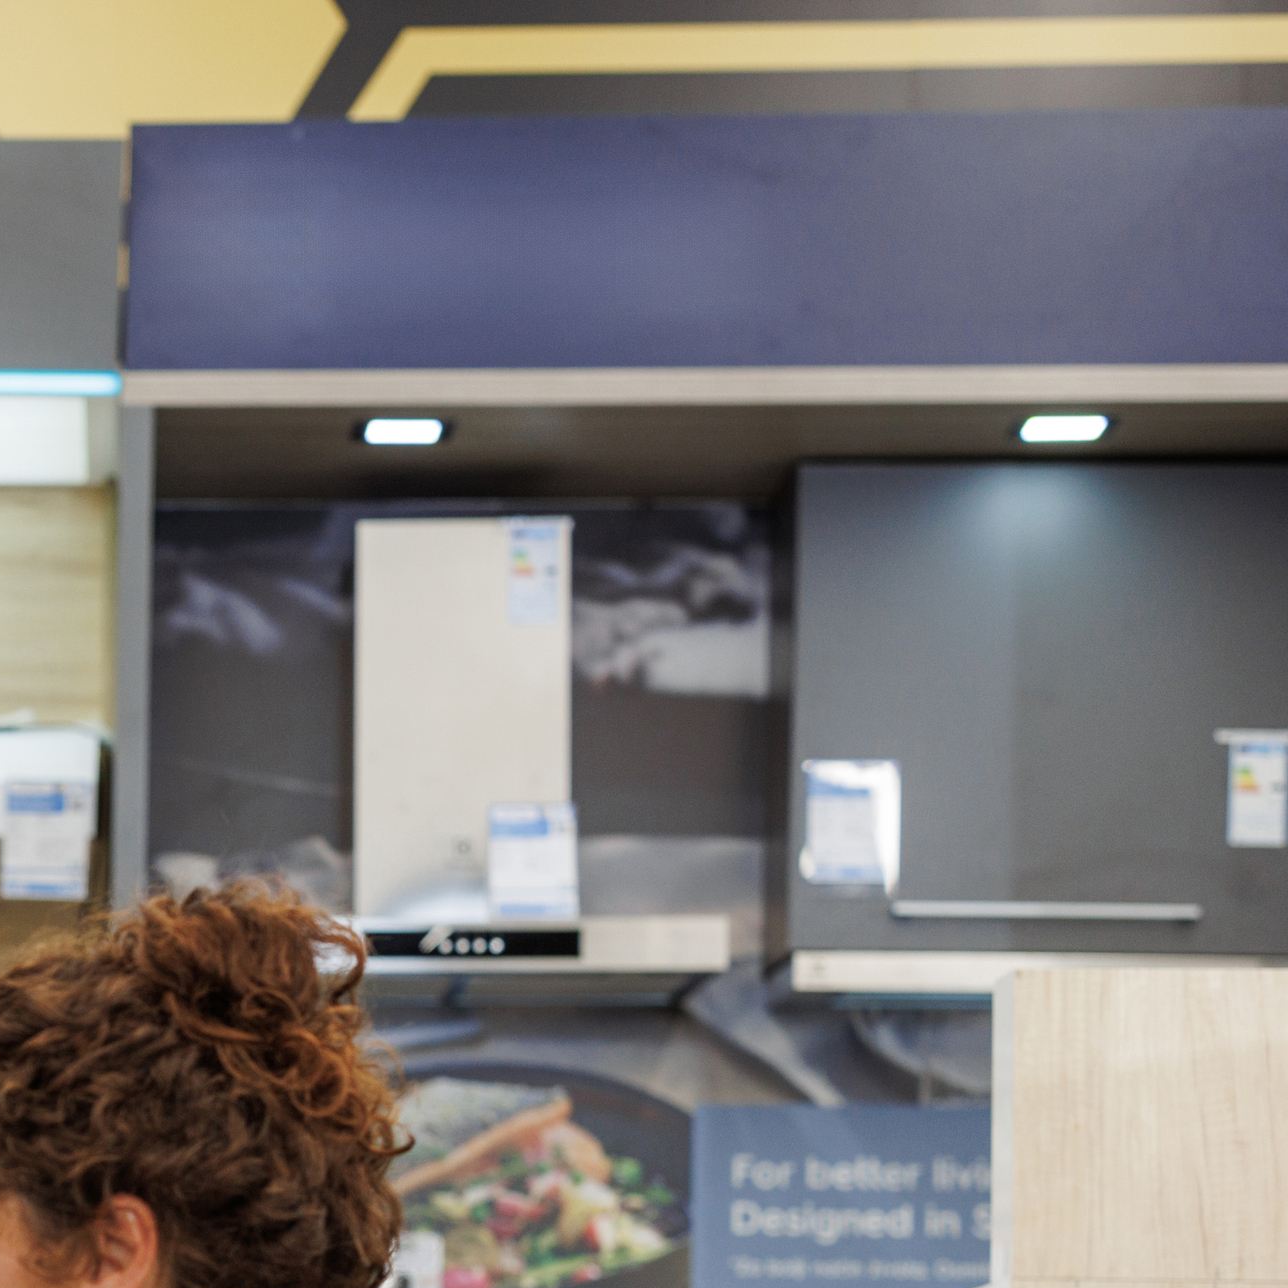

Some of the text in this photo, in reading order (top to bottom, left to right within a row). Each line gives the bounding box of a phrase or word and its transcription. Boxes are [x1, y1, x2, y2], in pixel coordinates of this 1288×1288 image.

[731, 1153, 793, 1191] For
[804, 1154, 921, 1191] better
[730, 1200, 913, 1246] Designed
[924, 1202, 962, 1240] in
